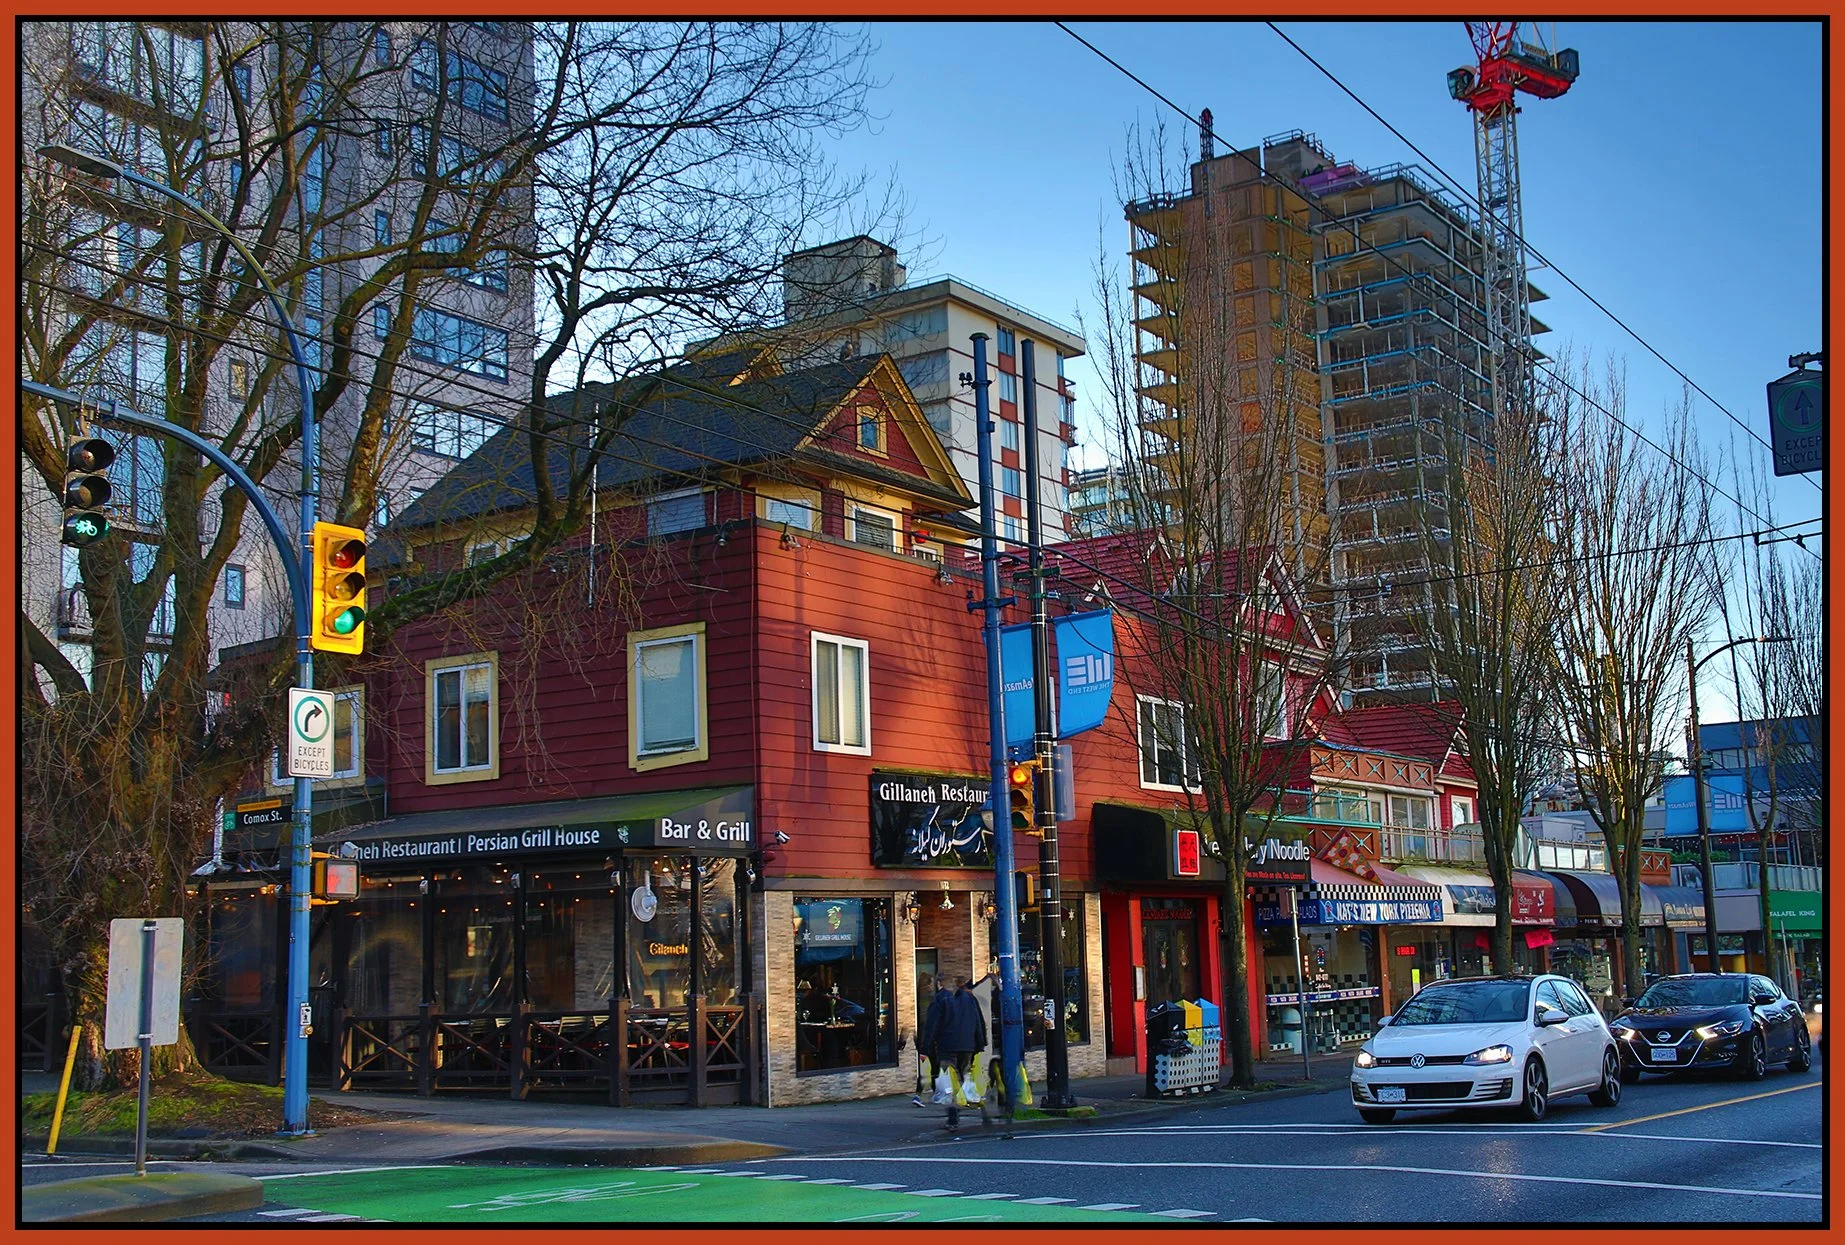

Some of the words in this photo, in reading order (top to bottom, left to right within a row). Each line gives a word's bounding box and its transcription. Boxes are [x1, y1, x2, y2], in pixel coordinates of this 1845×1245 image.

[1785, 436, 1822, 450] EXCEP
[298, 746, 326, 758] EXCEPT
[294, 758, 330, 772] BICYCLES
[880, 782, 936, 804] Gillaneh
[941, 784, 988, 804] Restaur
[243, 814, 270, 824] Comox
[270, 810, 282, 822] St.
[662, 818, 692, 838] Bar
[696, 820, 711, 840] &
[716, 822, 750, 842] Grill
[328, 842, 379, 860] Gineh
[382, 838, 456, 858] Restaurant
[468, 834, 516, 852] Persian
[522, 828, 550, 847] Grill
[554, 829, 600, 846] House
[1270, 838, 1310, 860] Noodle
[1259, 907, 1274, 920] PIZZA
[1298, 905, 1318, 919] ALADS
[1336, 902, 1359, 920] NAT'S
[1360, 903, 1377, 921] NEW
[1379, 902, 1400, 920] YORK
[1400, 902, 1432, 920] PIZZERIA
